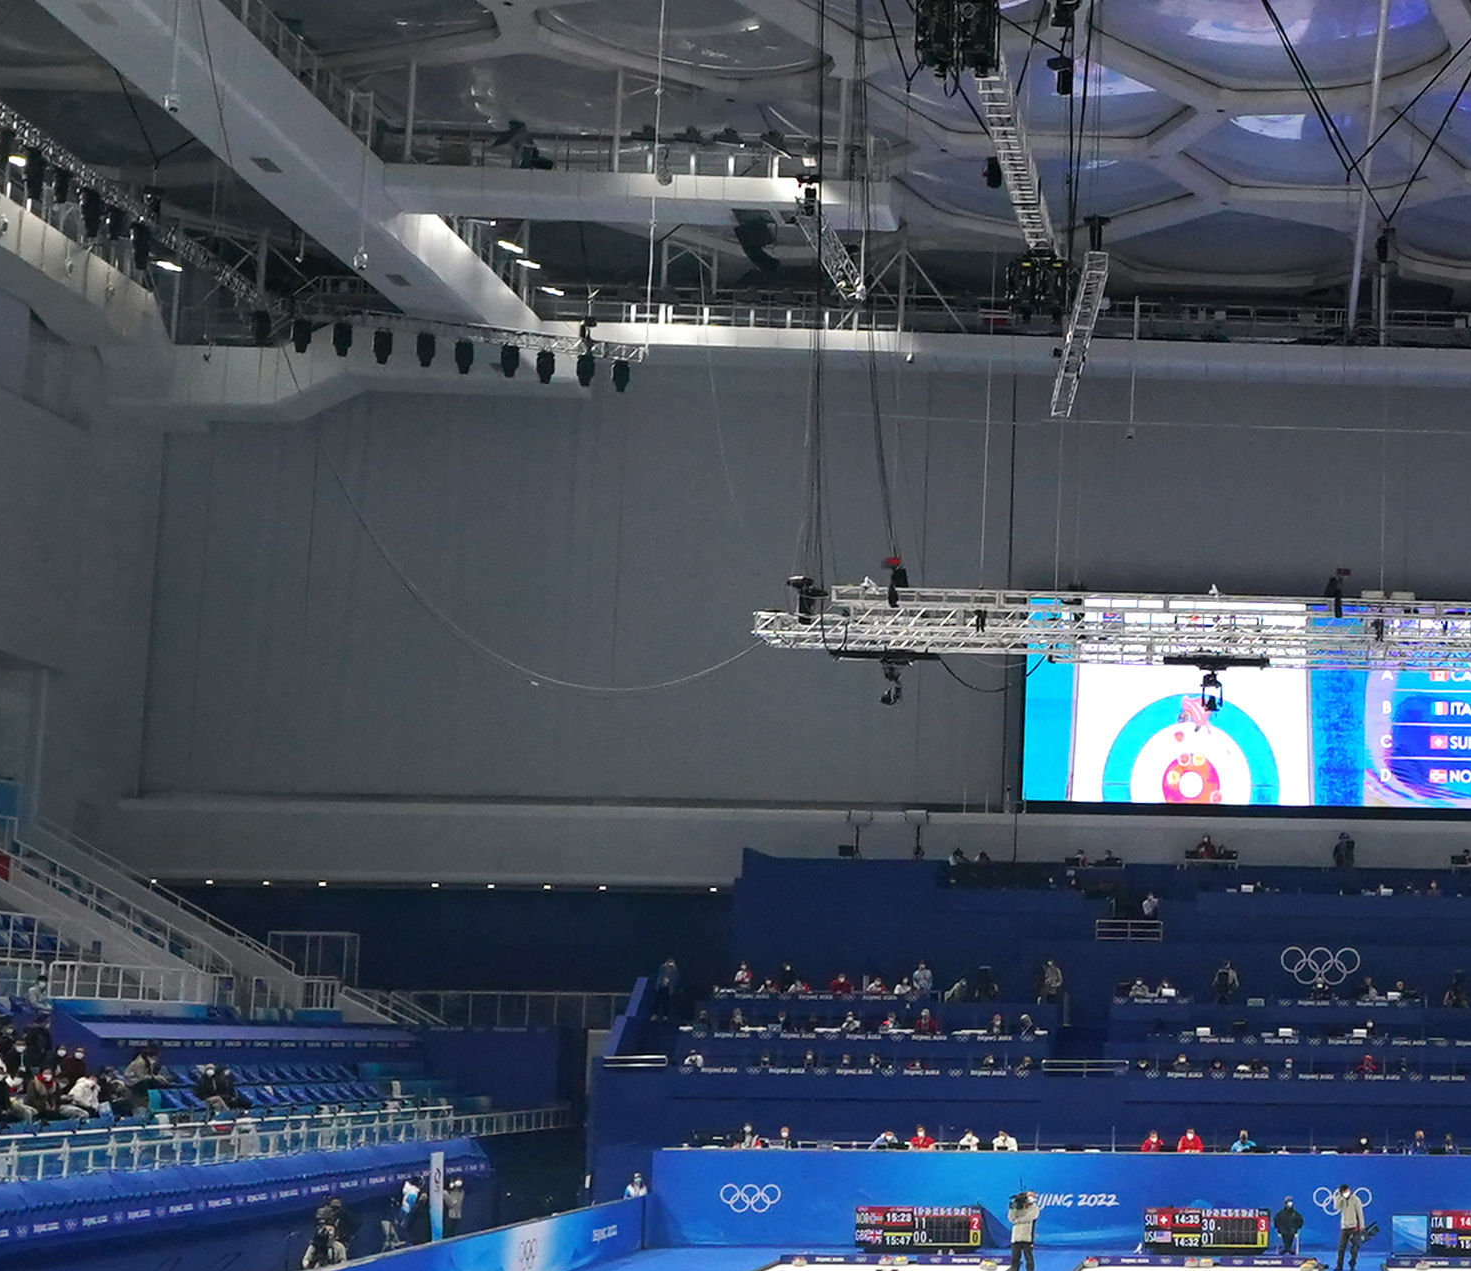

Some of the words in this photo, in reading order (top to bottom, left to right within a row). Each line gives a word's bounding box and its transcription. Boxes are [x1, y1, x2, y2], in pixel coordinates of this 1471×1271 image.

[1382, 701, 1392, 714] B
[1379, 735, 1393, 749] C
[1380, 769, 1392, 783] D
[1077, 1194, 1119, 1206] 2022
[972, 1218, 978, 1229] 2
[1259, 1219, 1266, 1231] 3
[1431, 1216, 1444, 1228] ITA
[971, 1233, 978, 1244] 0
